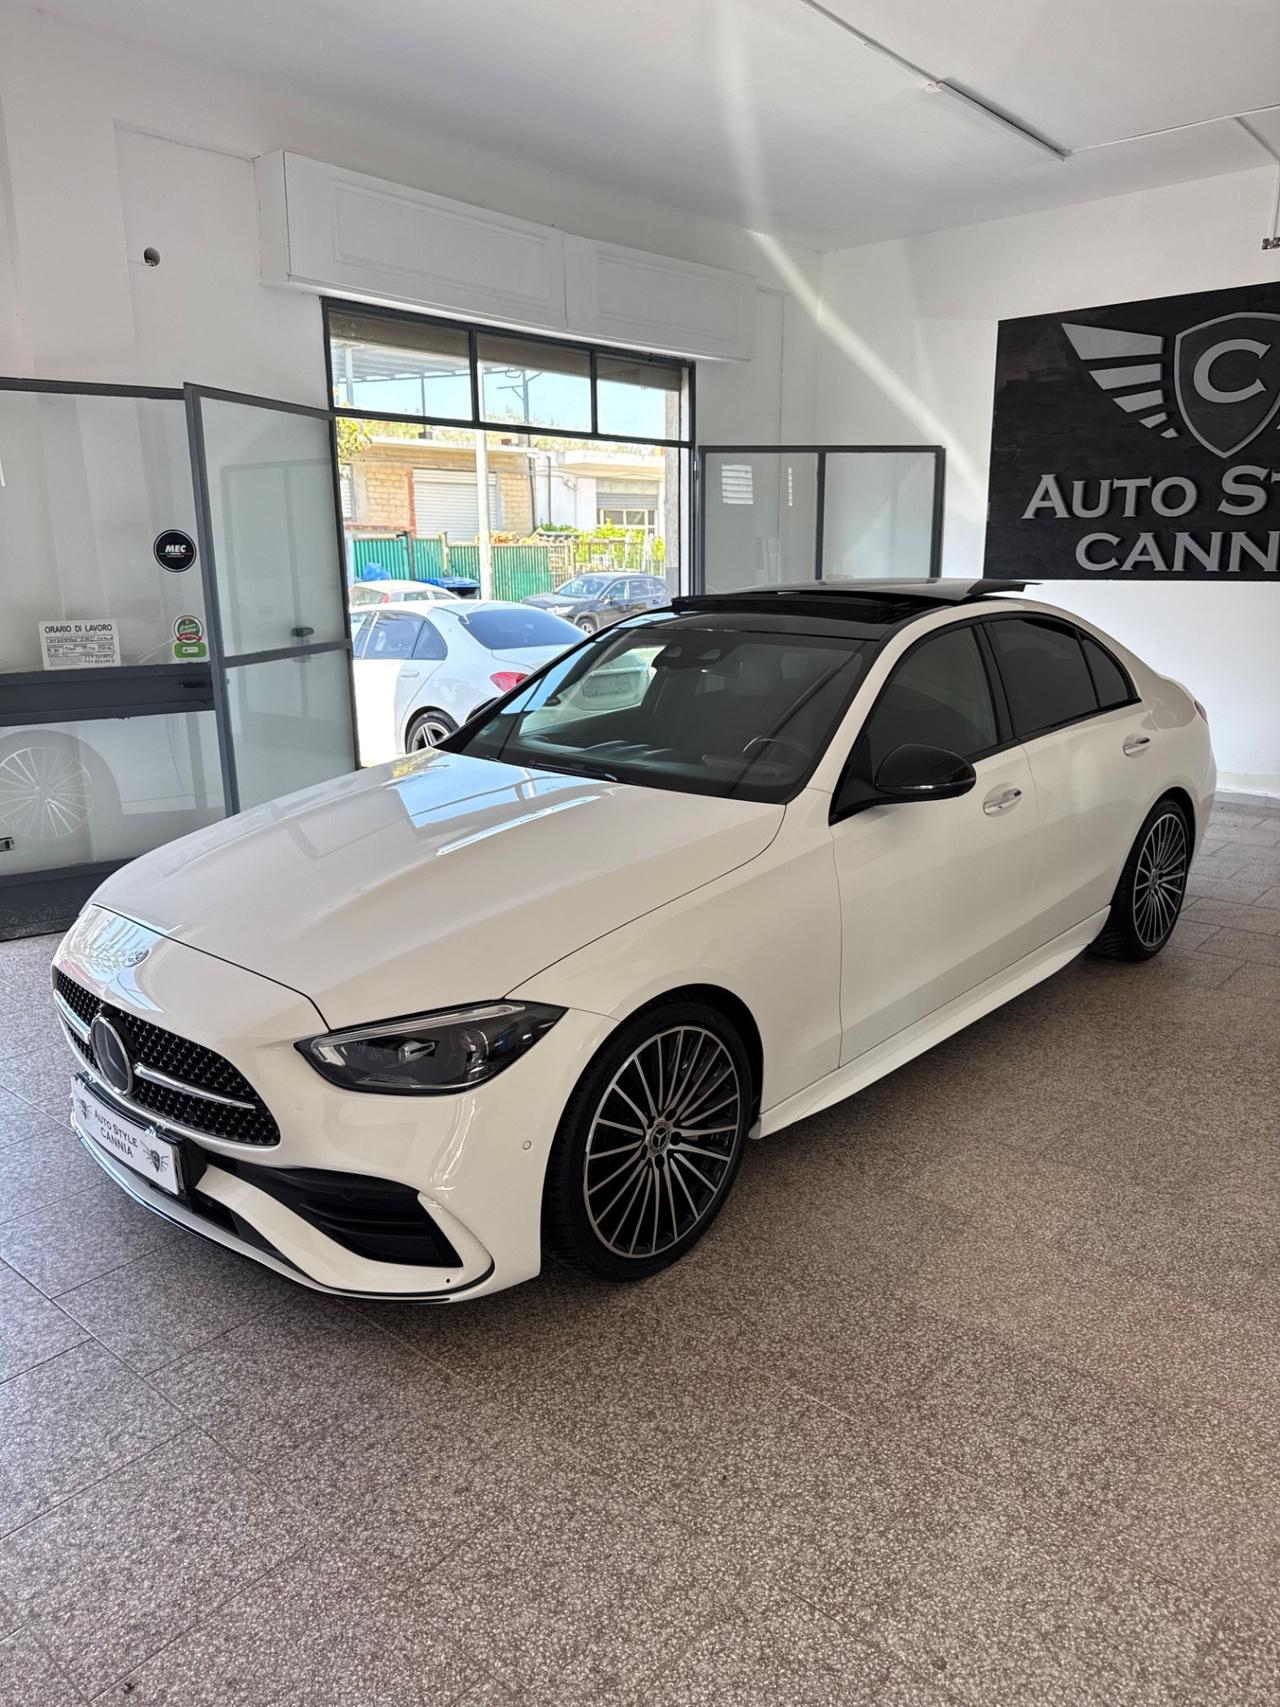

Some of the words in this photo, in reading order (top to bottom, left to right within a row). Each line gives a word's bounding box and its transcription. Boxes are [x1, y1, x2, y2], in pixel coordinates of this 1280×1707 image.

[1193, 338, 1272, 404] C
[1217, 465, 1280, 517] S
[165, 544, 187, 553] MEC
[45, 625, 72, 634] ORARIO
[85, 623, 113, 632] LAVORO
[94, 1109, 112, 1131] AUTO
[113, 1123, 138, 1148] STYLE
[100, 1127, 134, 1159] CANNIA
